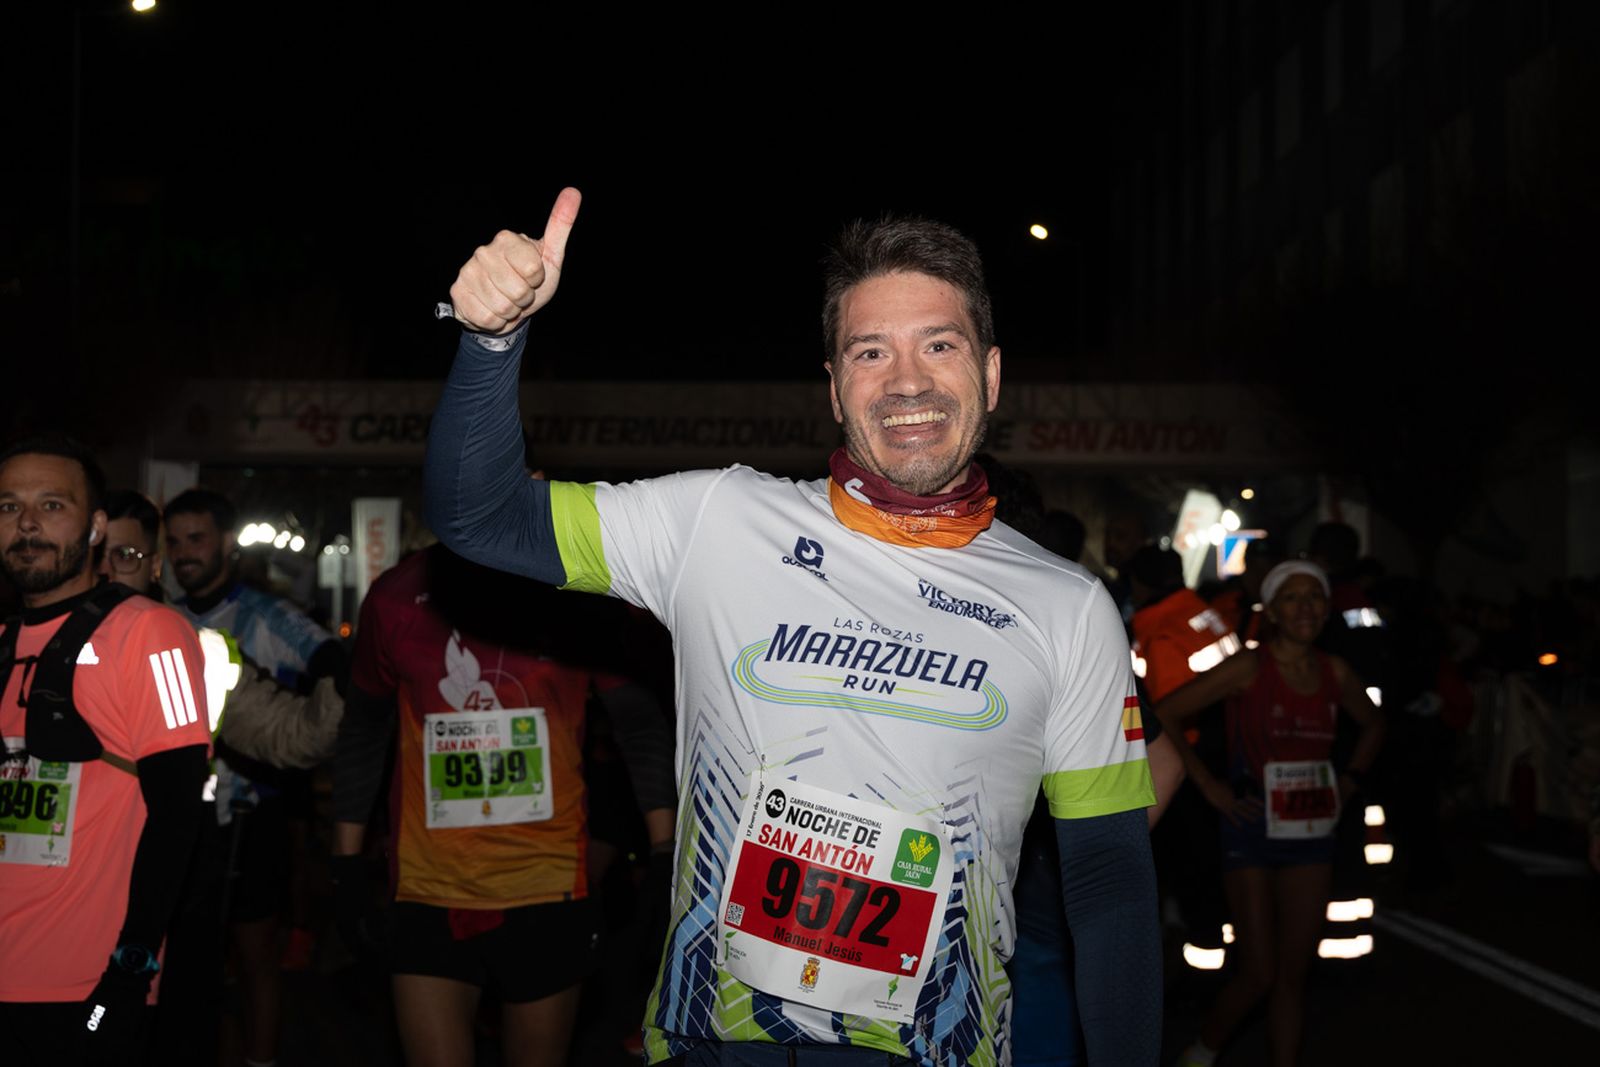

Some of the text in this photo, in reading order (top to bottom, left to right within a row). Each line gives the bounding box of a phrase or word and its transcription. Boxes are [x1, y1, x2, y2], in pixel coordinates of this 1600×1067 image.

[298, 404, 339, 447] 43
[526, 414, 825, 448] INTERNACIONAL
[1027, 421, 1097, 451] SAN
[833, 617, 925, 643] LAS ROZAS
[928, 600, 1004, 630] ENDURANCE
[764, 623, 989, 692] MARAZUELA
[843, 674, 897, 695] RUN
[445, 750, 527, 788] 9399
[766, 794, 786, 812] 43
[789, 797, 882, 829] CARRERA URBANA INTERNACIONAL
[785, 805, 882, 849] NOCHE DE
[758, 823, 875, 876] SAN ANTÓN
[761, 857, 901, 947] 9572
[773, 926, 864, 962] Manuel Jesús
